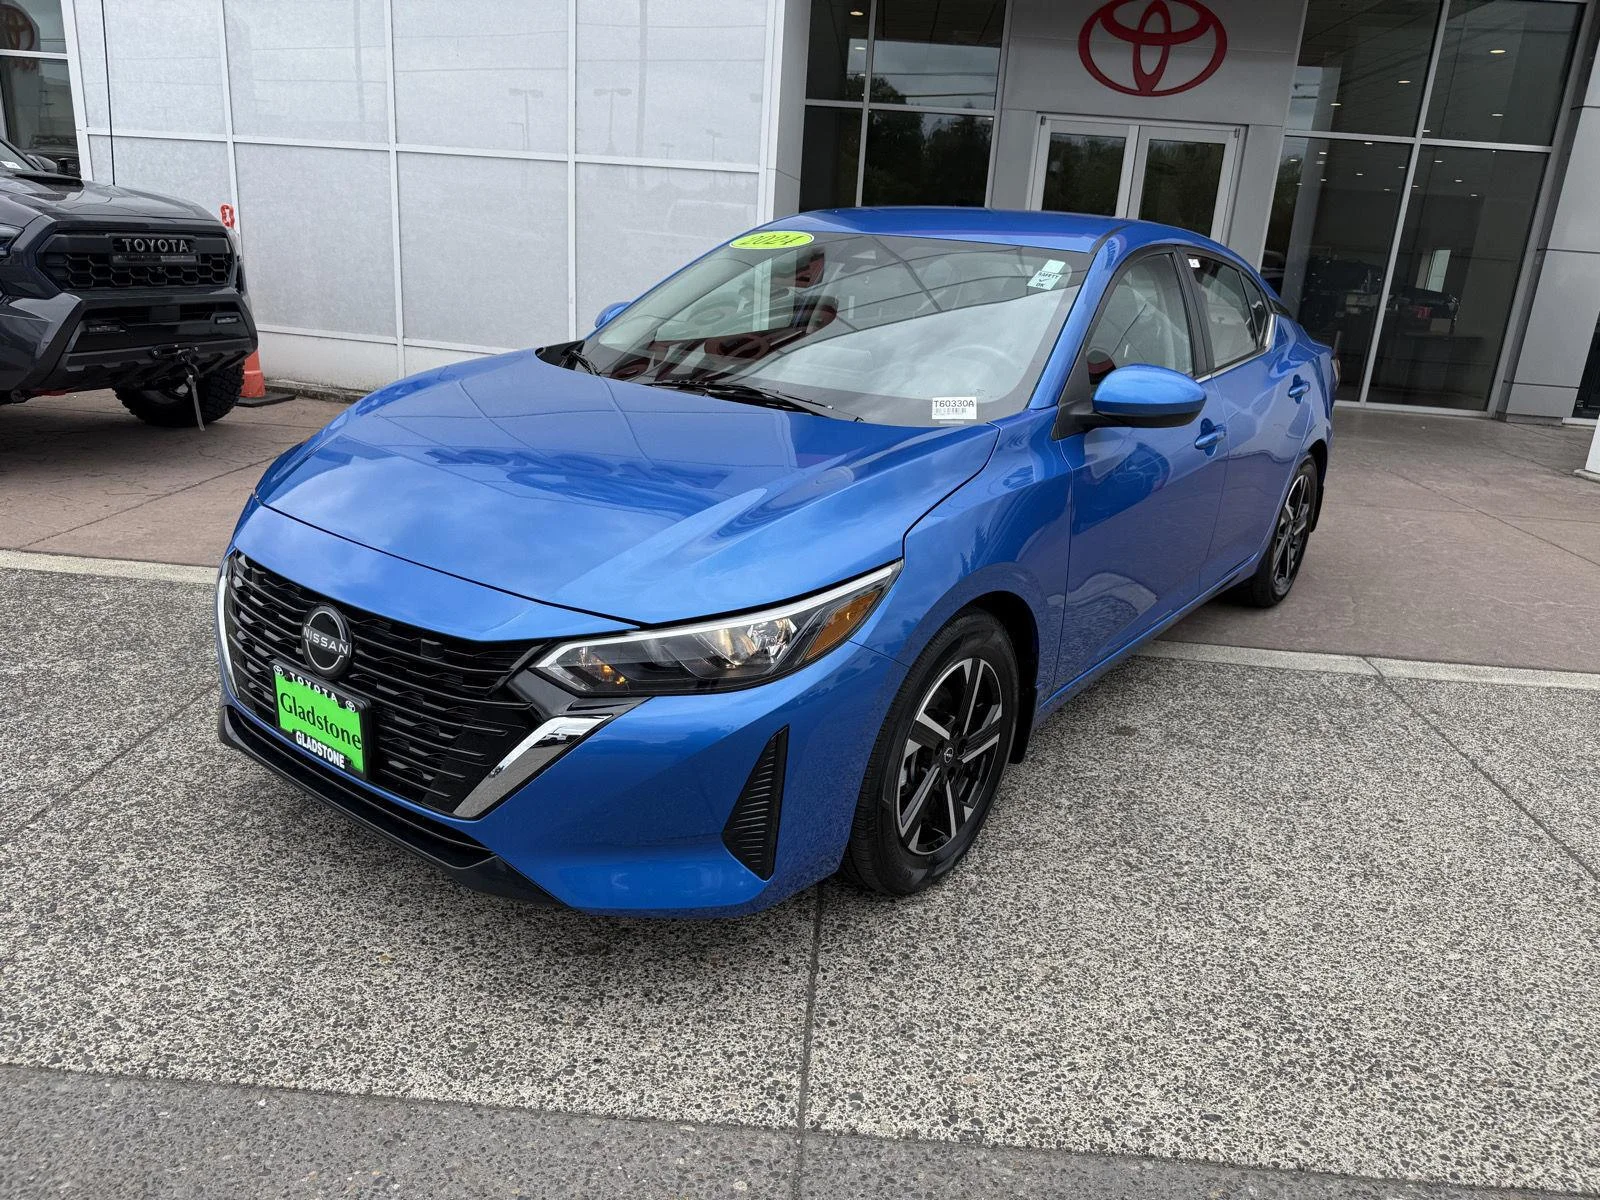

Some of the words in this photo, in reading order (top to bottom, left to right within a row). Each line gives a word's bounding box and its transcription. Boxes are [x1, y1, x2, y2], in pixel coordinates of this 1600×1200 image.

[121, 238, 189, 253] TOYOTA
[738, 234, 804, 245] 2024
[1038, 272, 1060, 280] SAFETY
[933, 399, 975, 408] T60330A
[303, 627, 349, 654] NISSAN
[289, 672, 338, 703] TOYOTA
[280, 692, 362, 750] Gladstone
[295, 731, 346, 769] GLADSTONE
